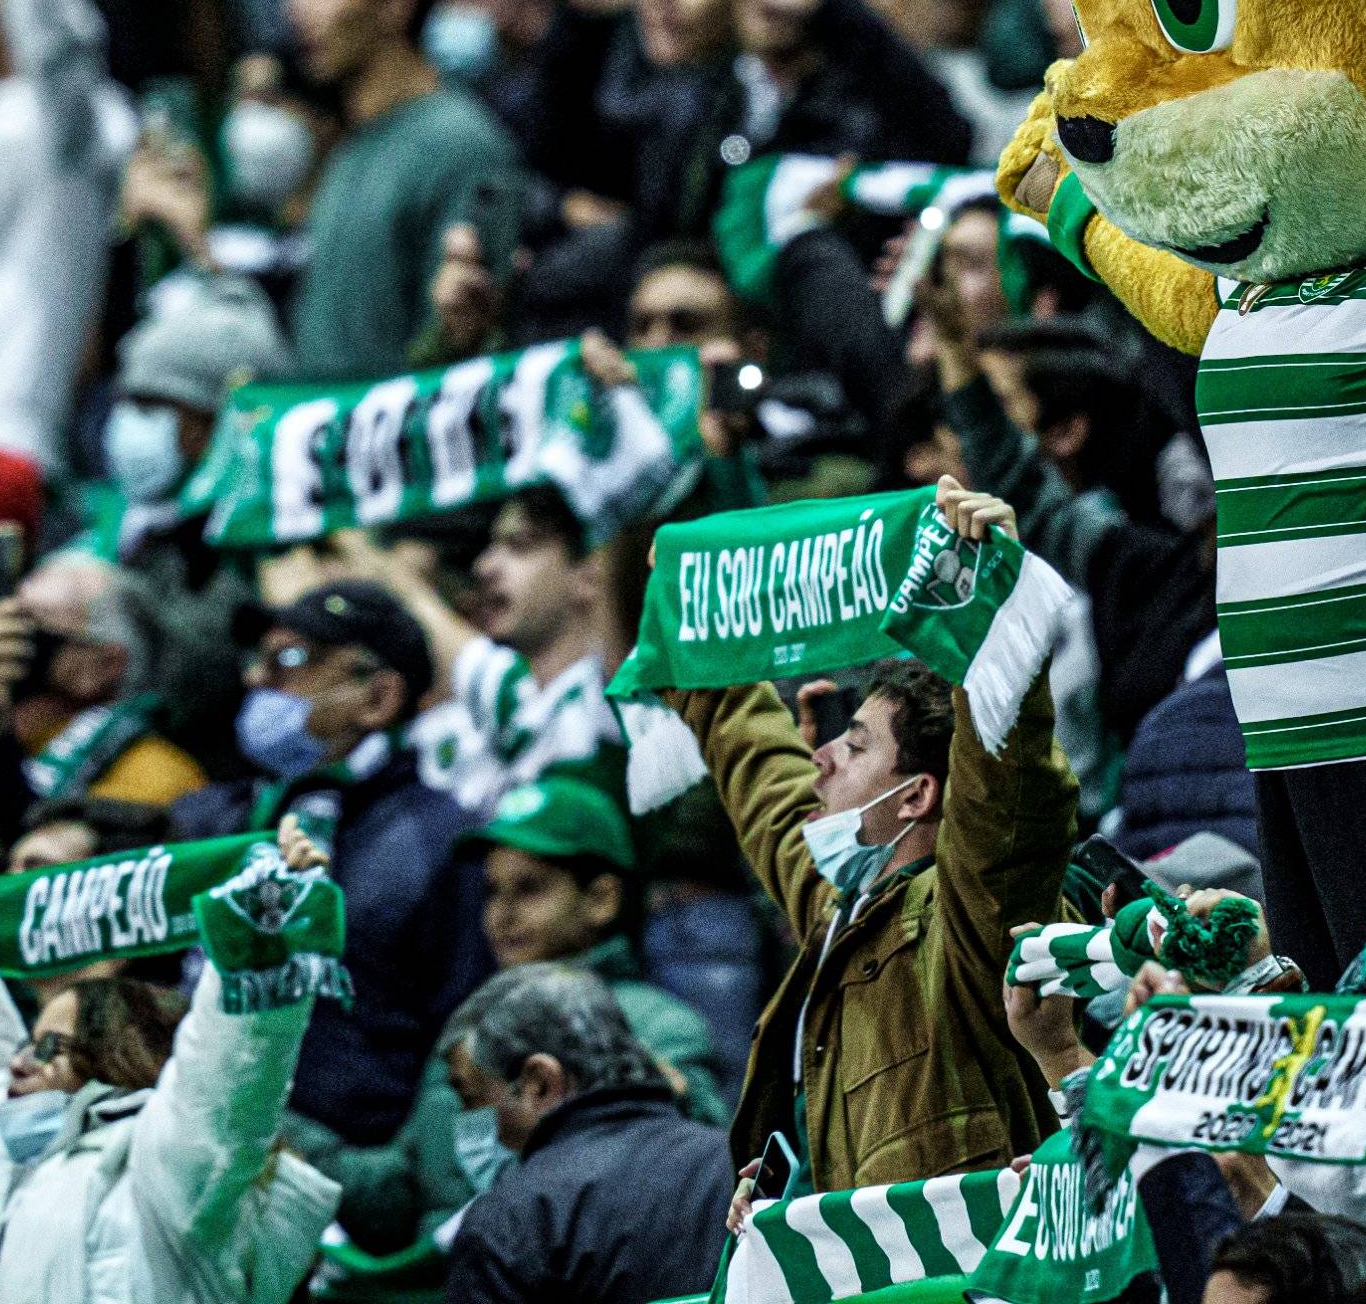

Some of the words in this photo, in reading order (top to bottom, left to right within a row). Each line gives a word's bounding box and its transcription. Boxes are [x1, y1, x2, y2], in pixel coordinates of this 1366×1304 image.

[678, 551, 712, 642] EU
[714, 546, 765, 640] SOU
[767, 507, 889, 634] CAMPEÃO
[19, 845, 173, 966] CAMPEÃO
